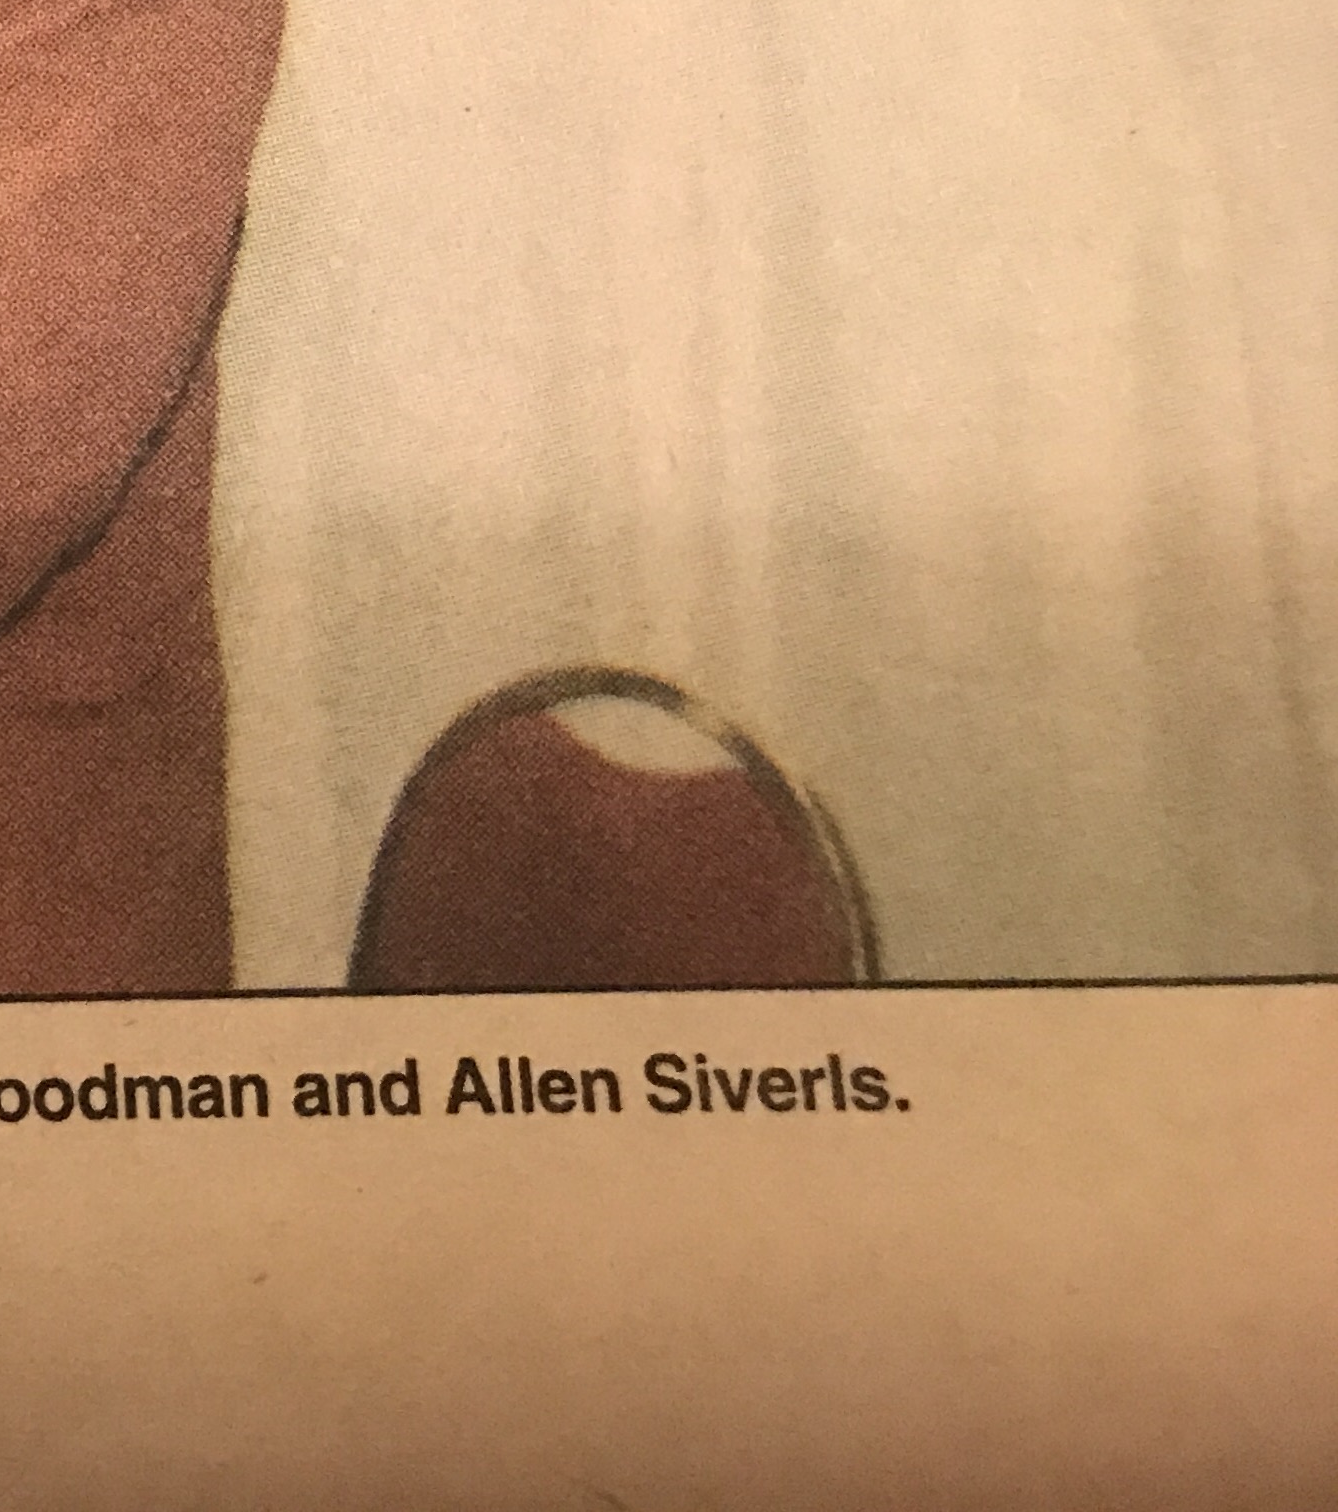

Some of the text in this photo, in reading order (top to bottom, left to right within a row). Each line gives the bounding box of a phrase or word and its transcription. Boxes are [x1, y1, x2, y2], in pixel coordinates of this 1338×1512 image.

[291, 1057, 422, 1119] and
[445, 1055, 624, 1116] Allen
[643, 1052, 911, 1115] Siverls.
